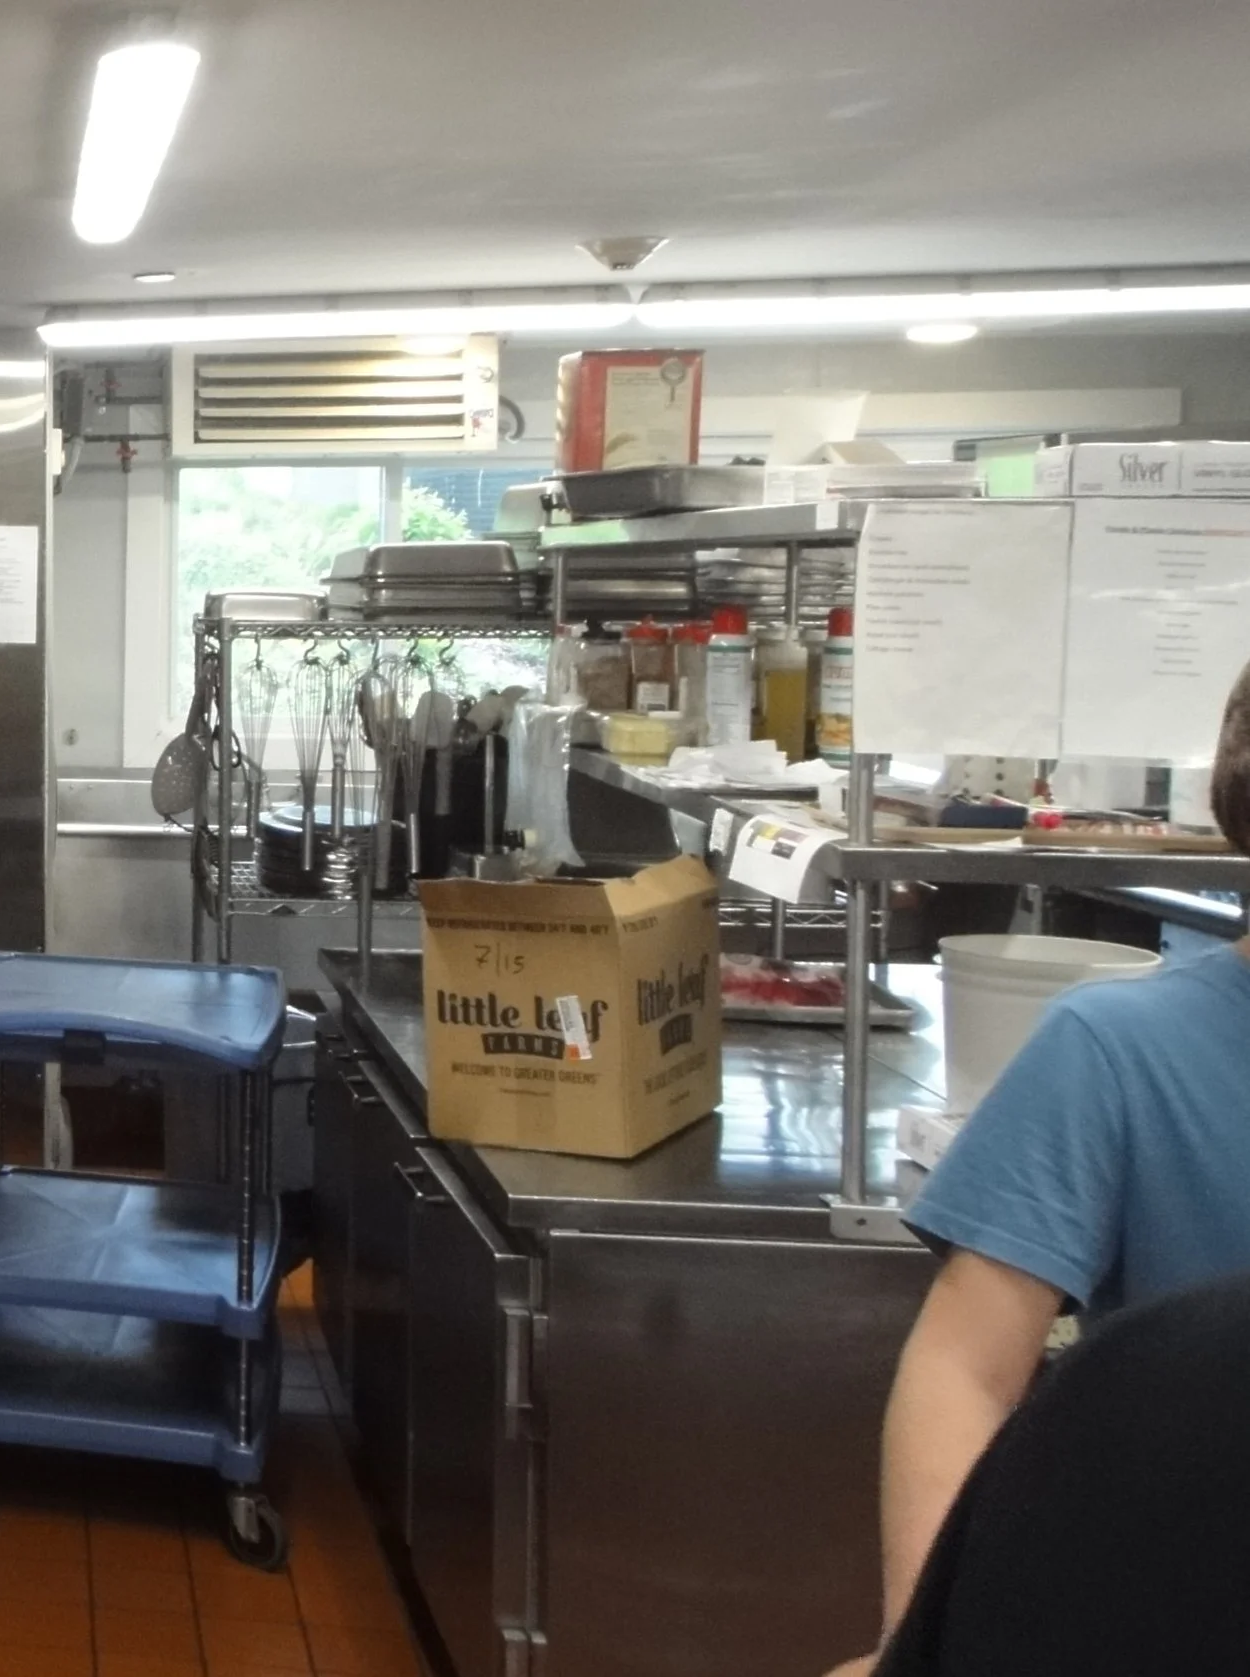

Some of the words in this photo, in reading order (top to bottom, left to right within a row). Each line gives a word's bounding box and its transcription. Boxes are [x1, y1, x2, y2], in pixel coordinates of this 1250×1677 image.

[474, 943, 525, 977] 7/15
[437, 989, 521, 1029] little
[534, 994, 609, 1043] lef
